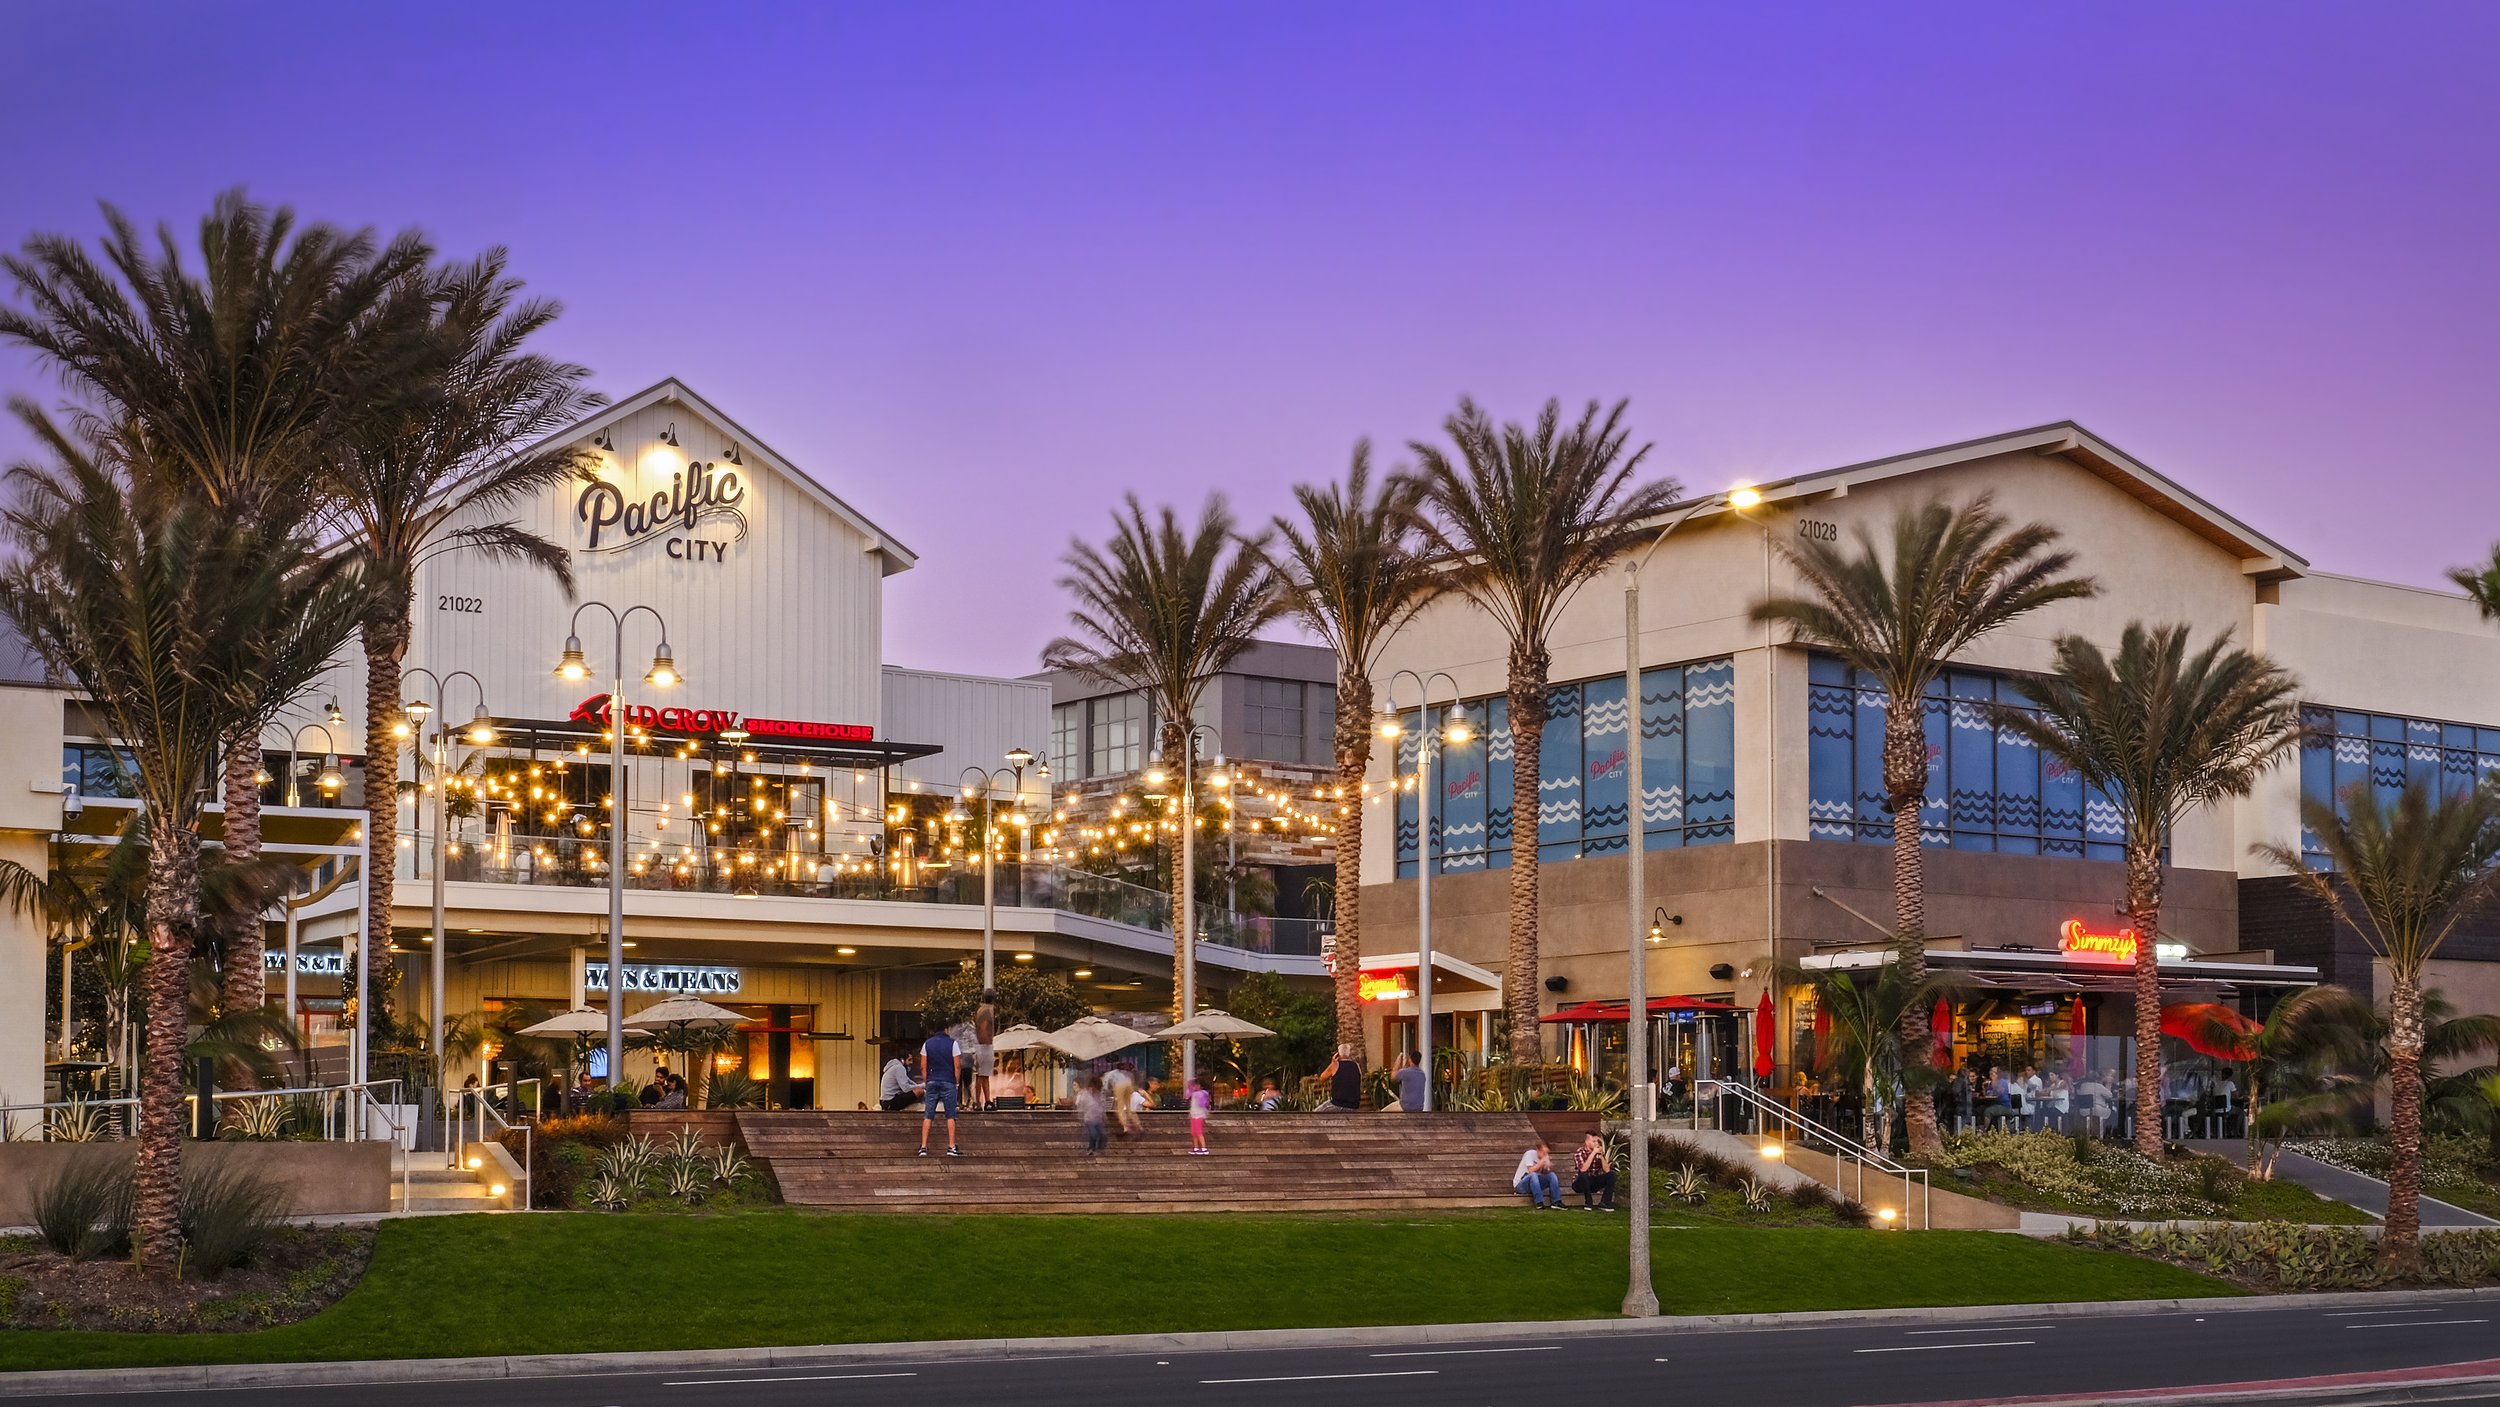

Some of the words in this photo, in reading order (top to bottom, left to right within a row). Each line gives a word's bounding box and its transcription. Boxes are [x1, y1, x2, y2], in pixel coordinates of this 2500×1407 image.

[578, 461, 743, 548] Pacific
[1800, 519, 1837, 541] 21028
[666, 537, 728, 563] CITY
[439, 595, 482, 613] 21022
[747, 719, 873, 739] SMOKEHOUSE
[1591, 750, 1625, 780] Pacific
[1609, 770, 1623, 779] CITY
[1448, 770, 1480, 800] Pacific
[1465, 791, 1478, 799] CITY
[2069, 921, 2137, 960] Simmzy's
[265, 955, 308, 970] WAS
[313, 957, 324, 970] &
[642, 970, 658, 989] &
[660, 971, 739, 991] MEANS
